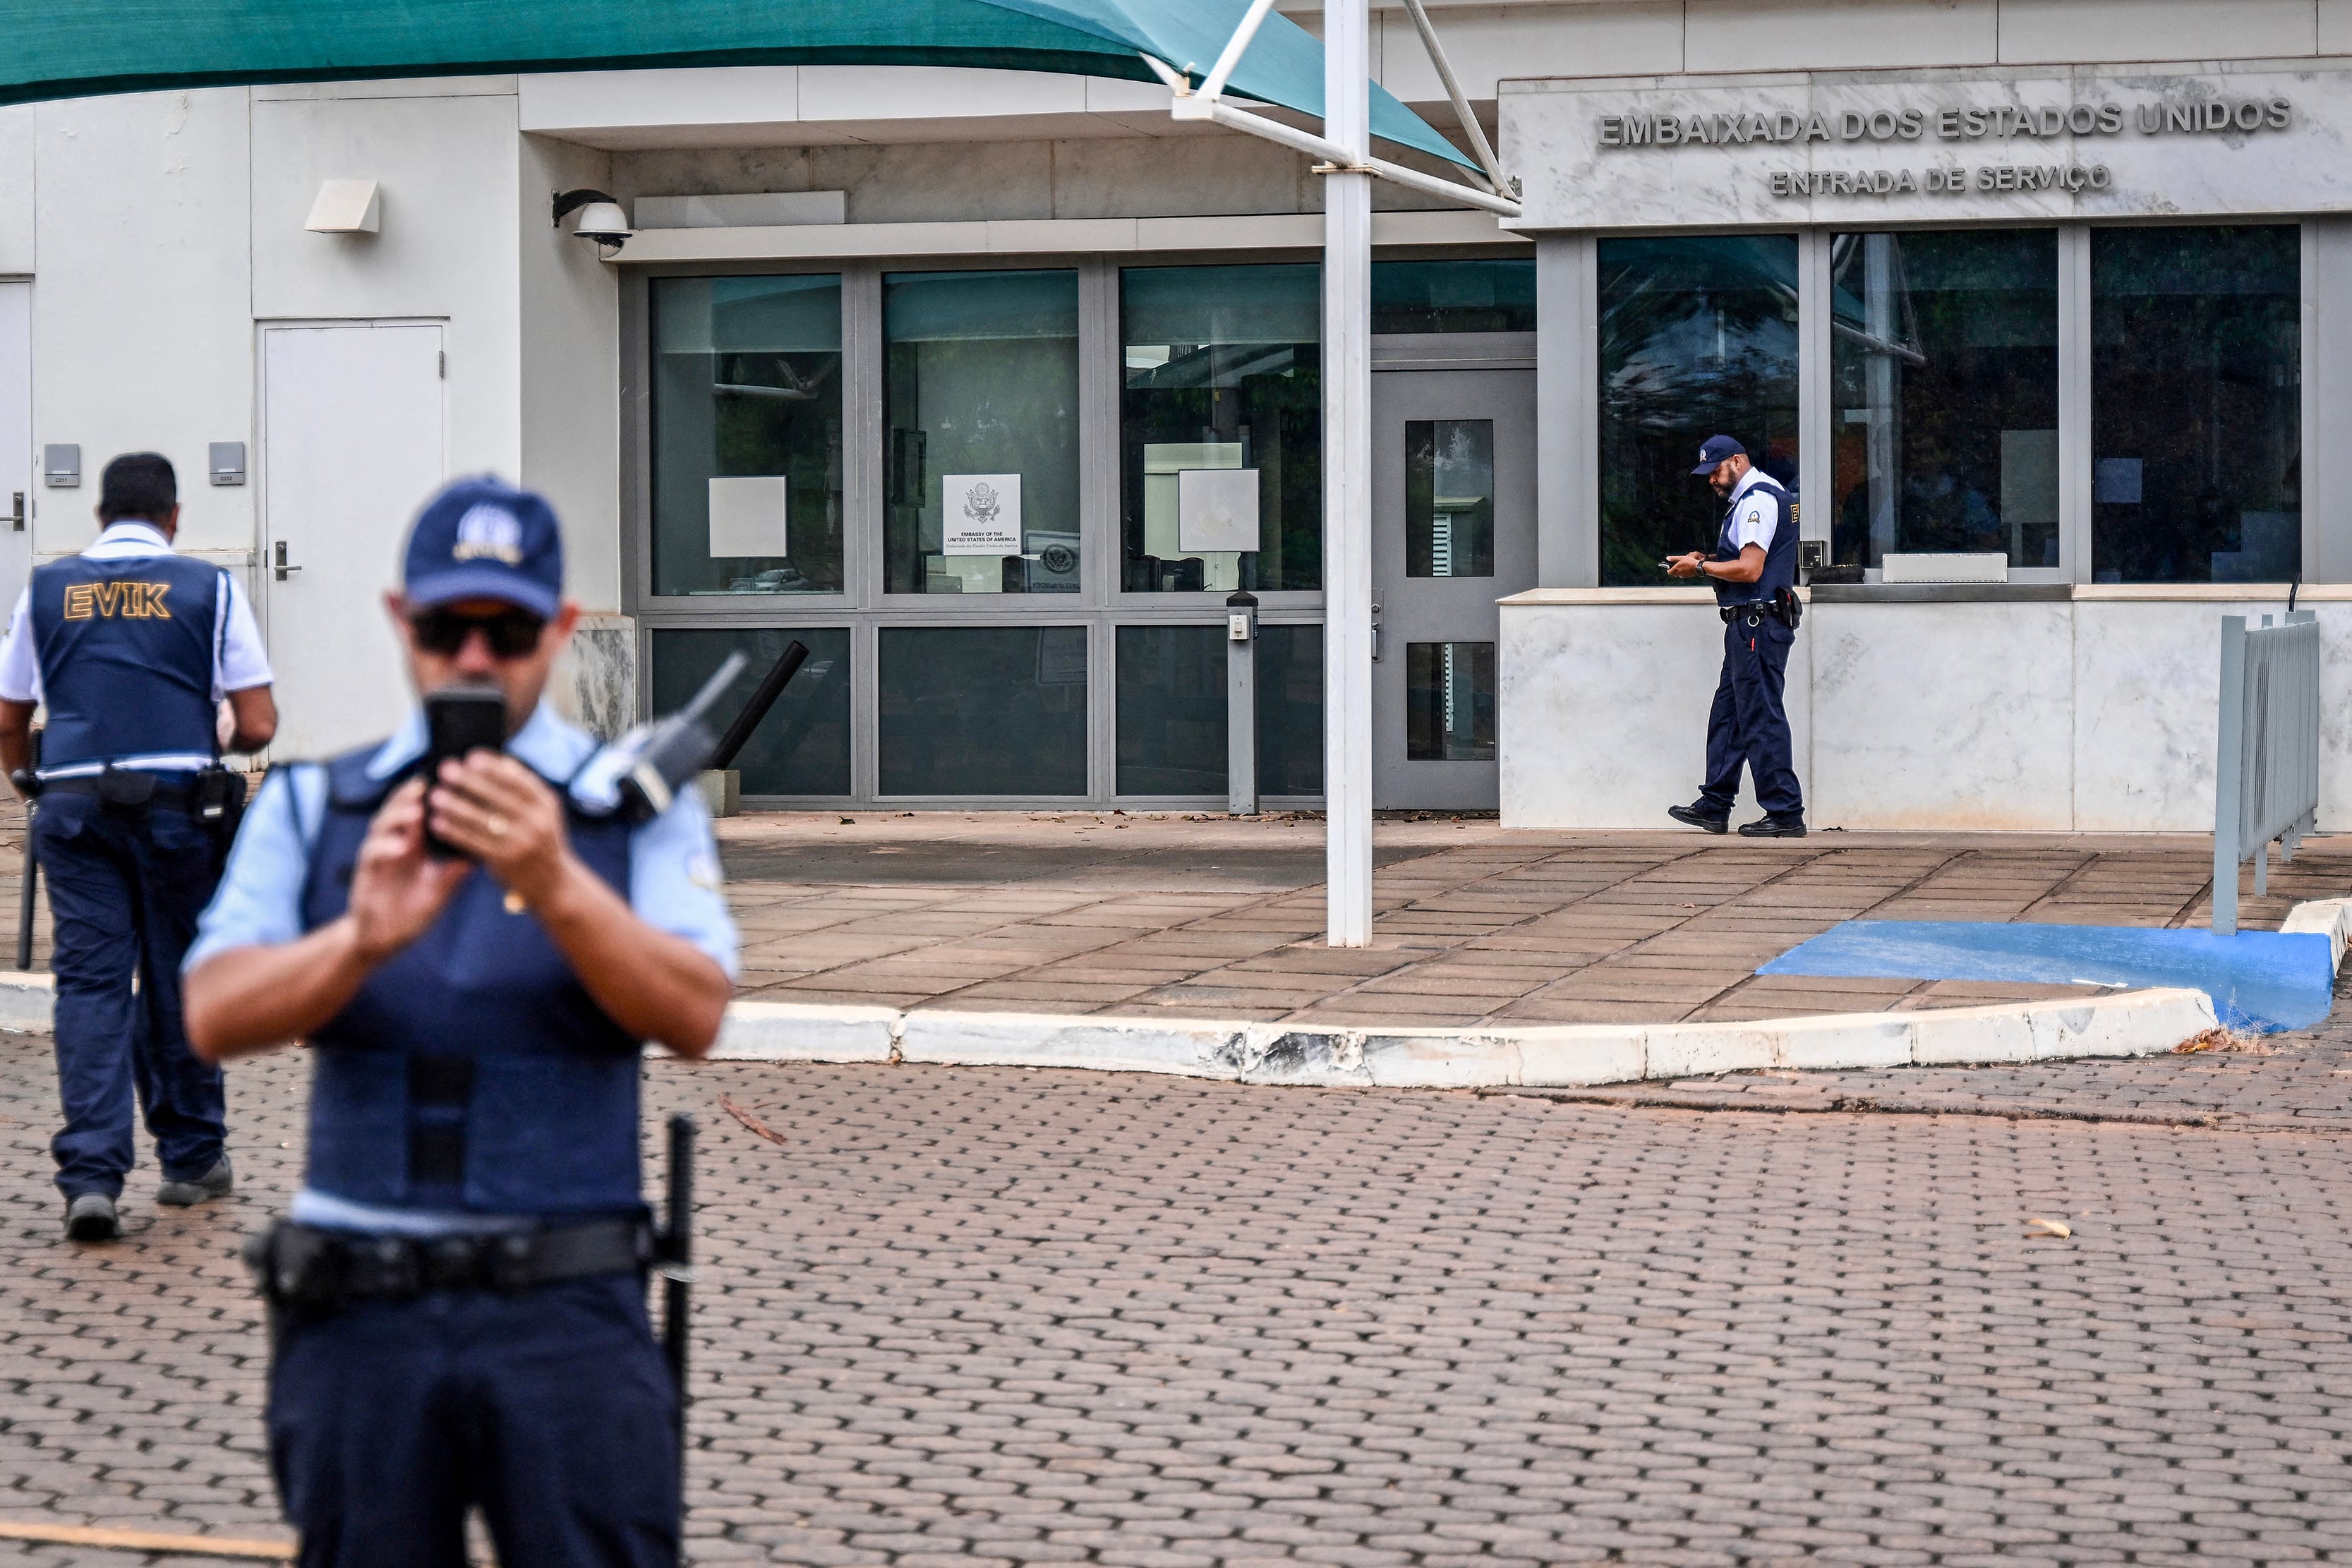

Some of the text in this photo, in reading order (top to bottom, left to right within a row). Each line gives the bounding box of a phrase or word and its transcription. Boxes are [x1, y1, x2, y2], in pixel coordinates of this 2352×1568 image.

[1598, 97, 2292, 144] EMBAIXADA DOS ESTADOS UNIDOS
[1770, 164, 2112, 195] ENTRADA DE SERVIÇO
[64, 581, 172, 620] EVIK
